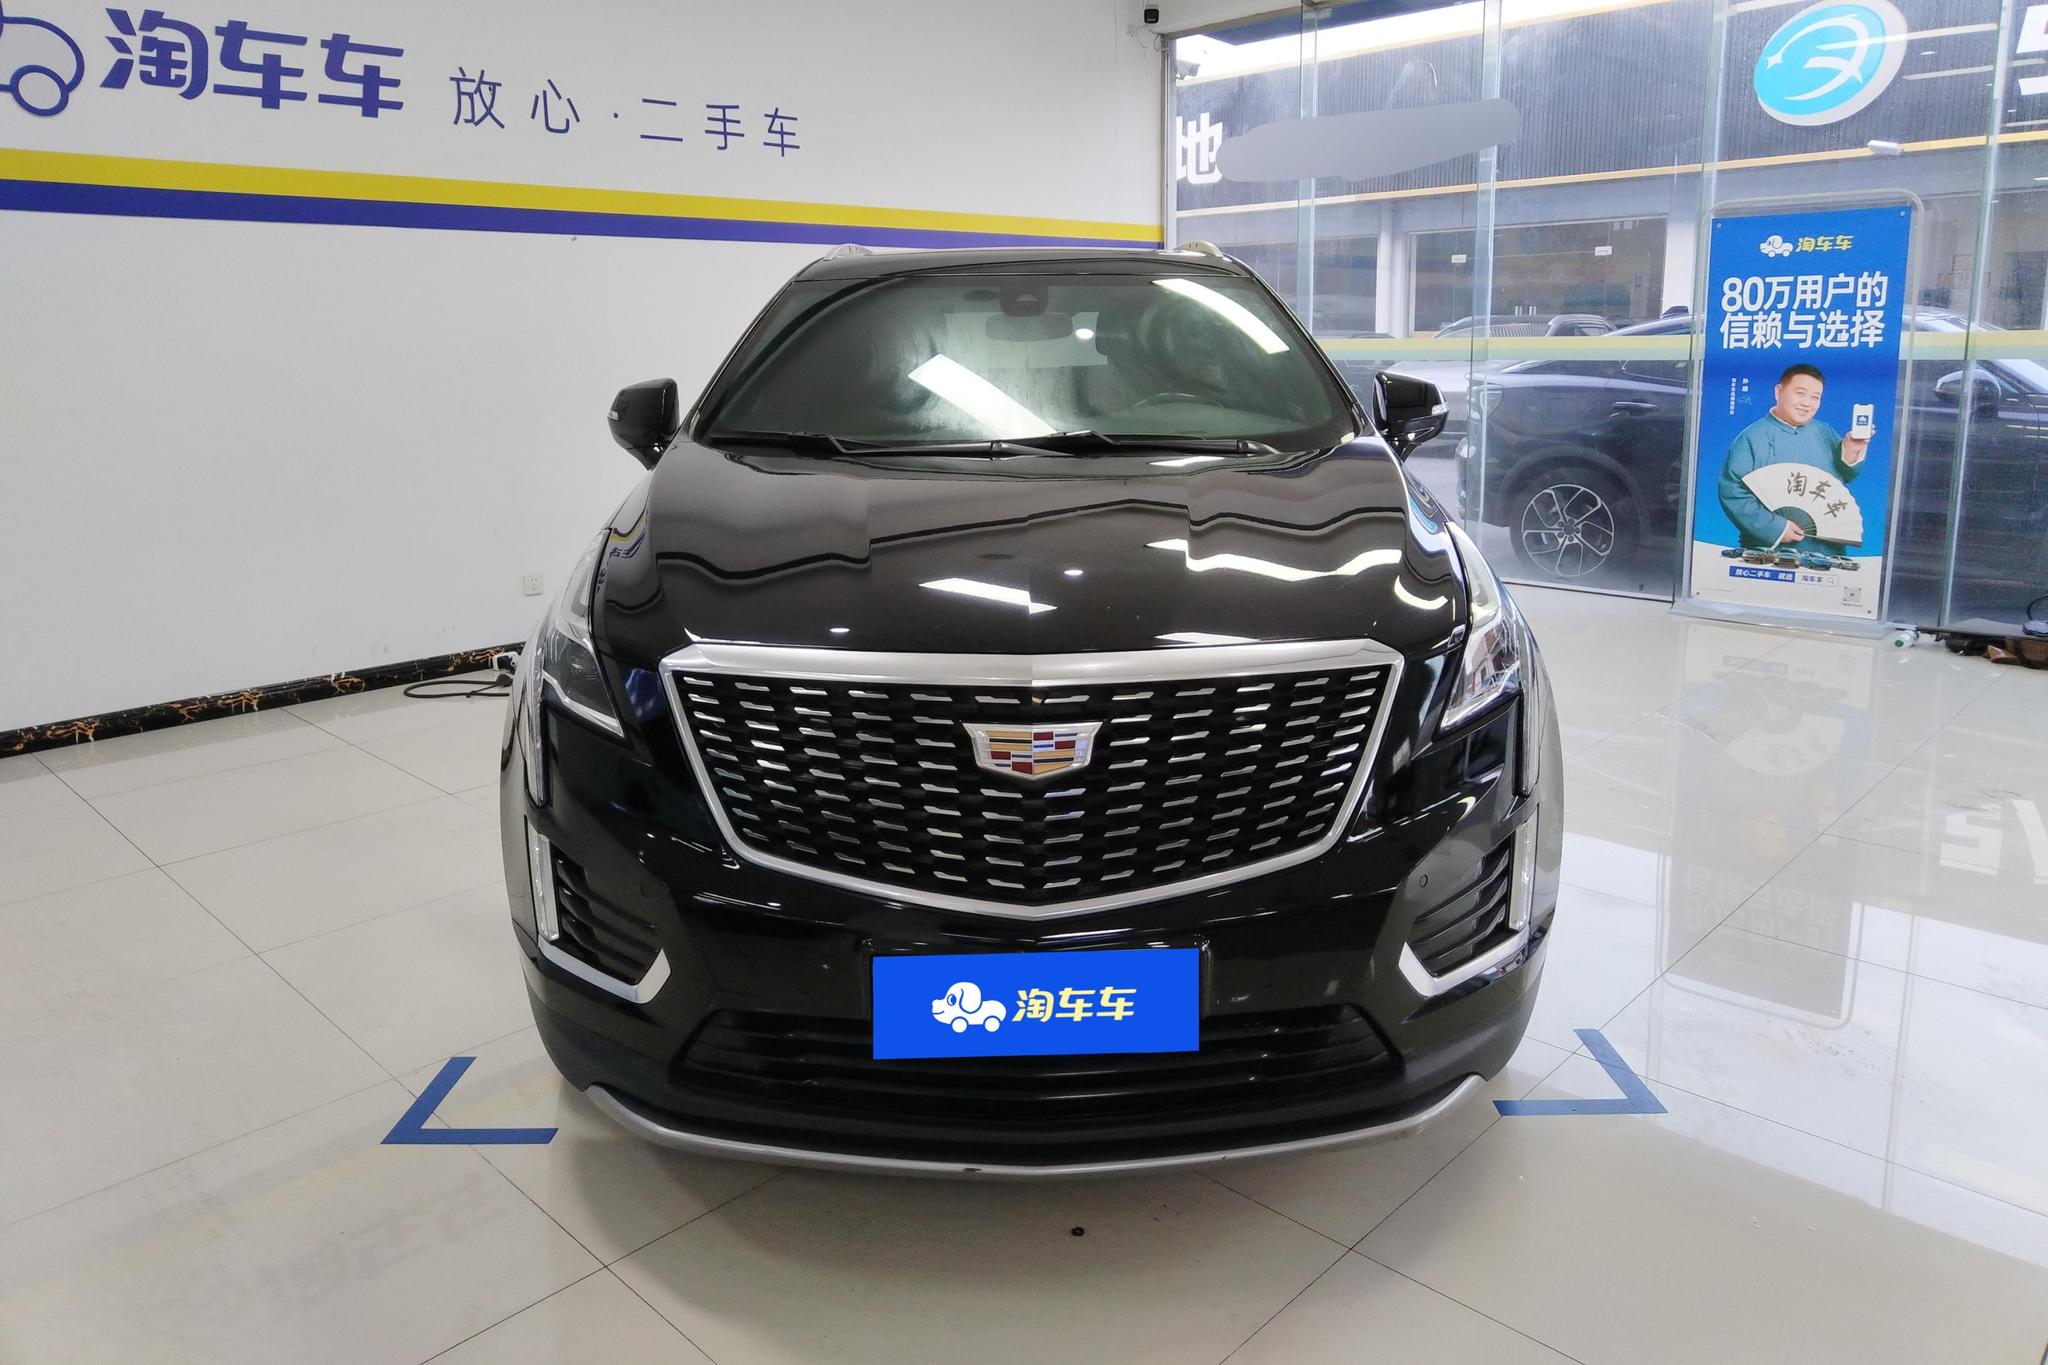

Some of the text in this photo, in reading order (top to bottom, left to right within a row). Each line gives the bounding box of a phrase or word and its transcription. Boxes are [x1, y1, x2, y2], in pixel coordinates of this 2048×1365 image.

[99, 8, 405, 119] 淘车车
[1795, 234, 1854, 253] 淘车车
[1720, 271, 1889, 313] 80万用户的
[1719, 309, 1886, 350] 信赖与选择
